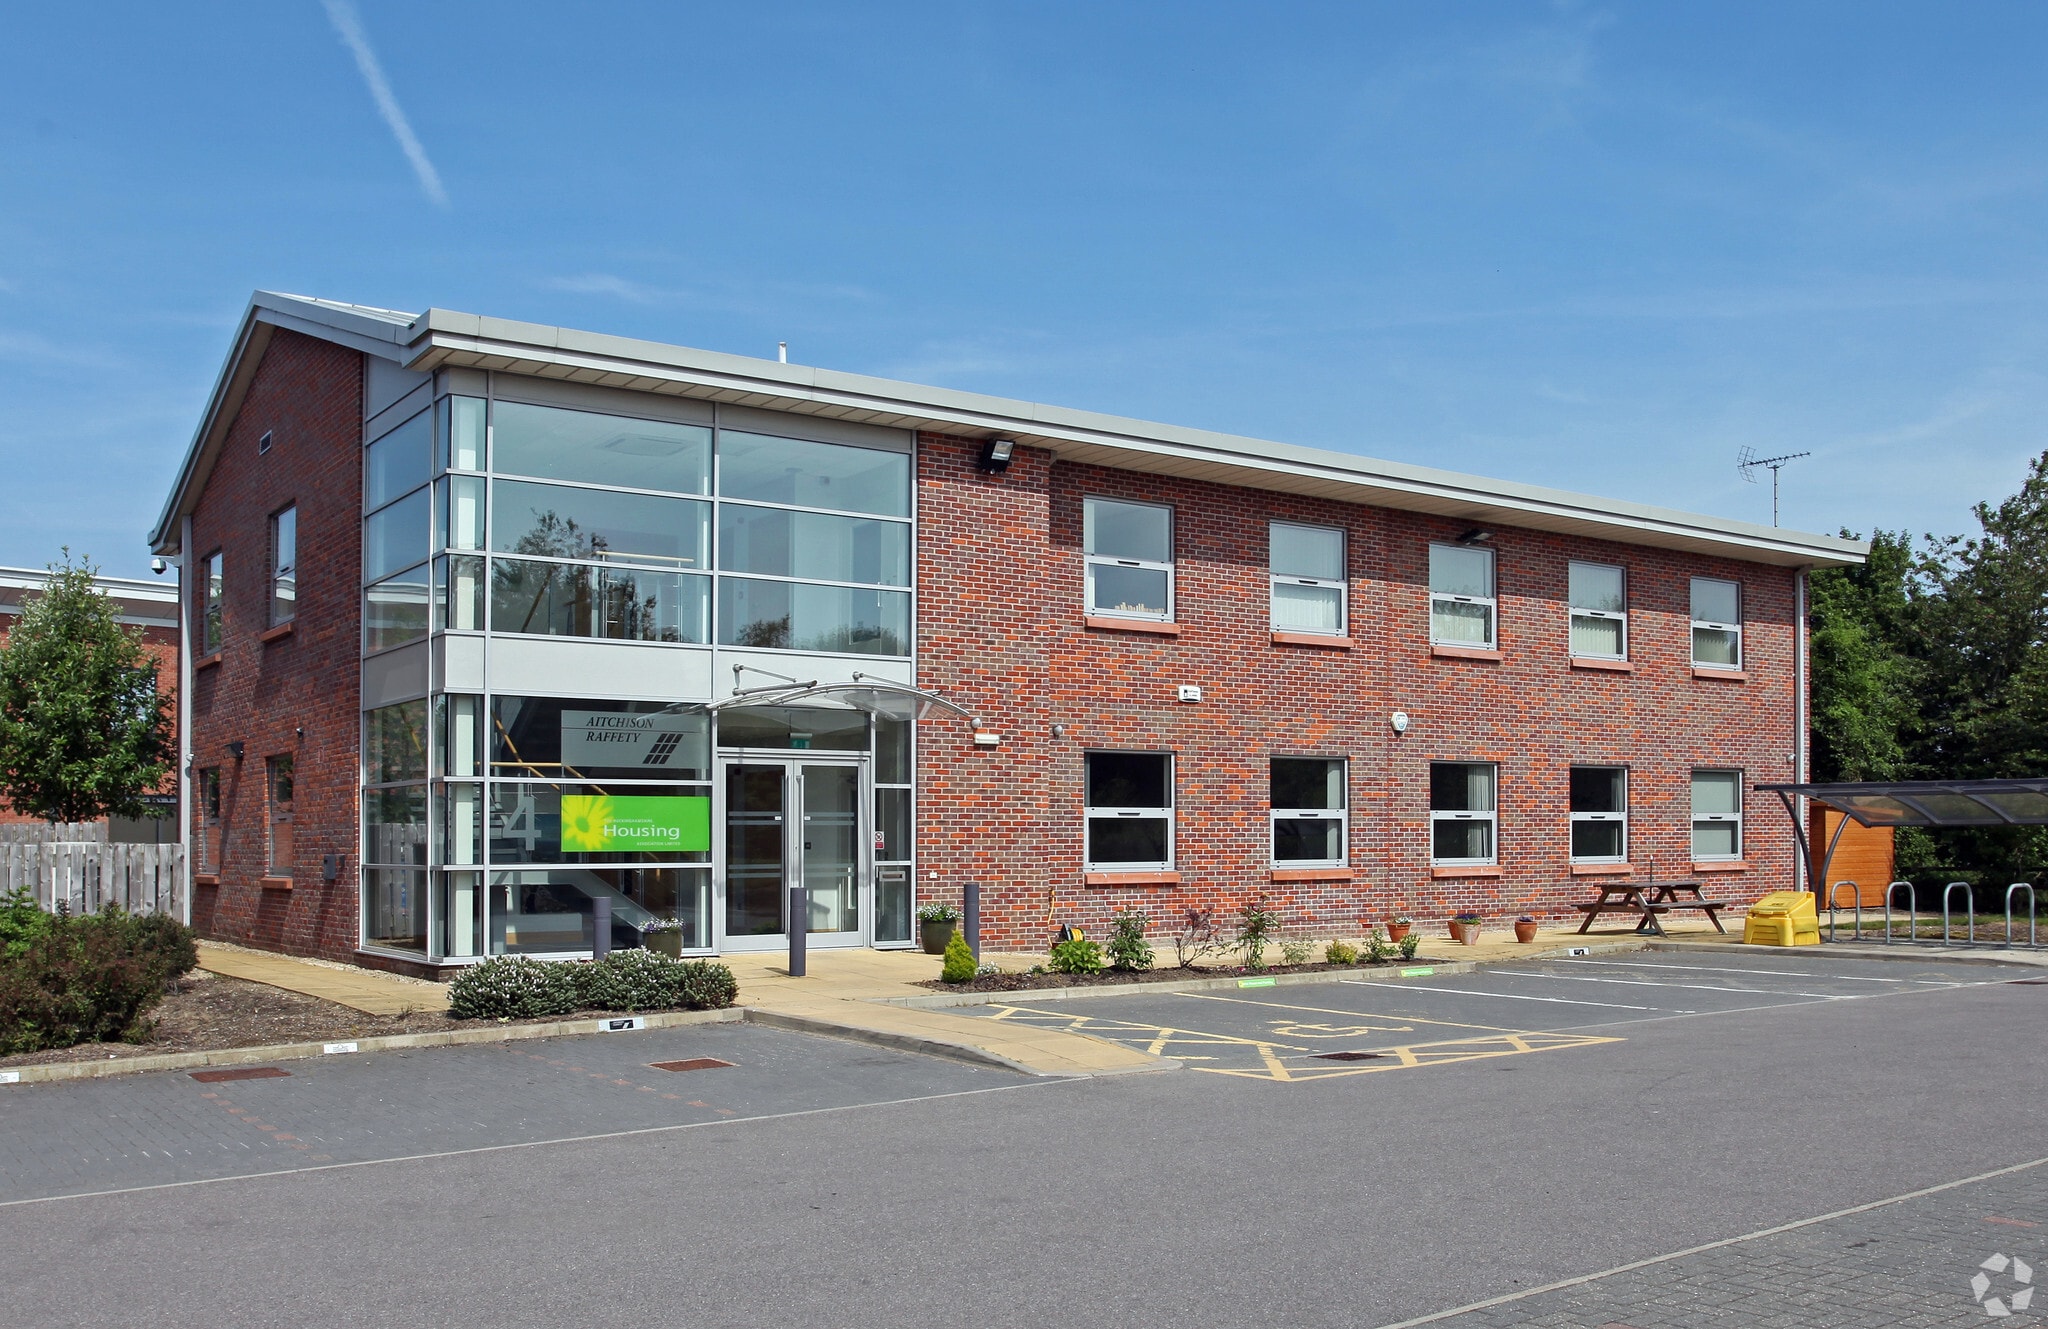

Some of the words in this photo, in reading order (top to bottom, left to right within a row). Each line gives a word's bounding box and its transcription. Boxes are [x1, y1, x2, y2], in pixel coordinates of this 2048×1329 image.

[586, 716, 655, 729] AITCHISON
[586, 731, 641, 743] RAFFETY
[603, 824, 680, 840] Housing
